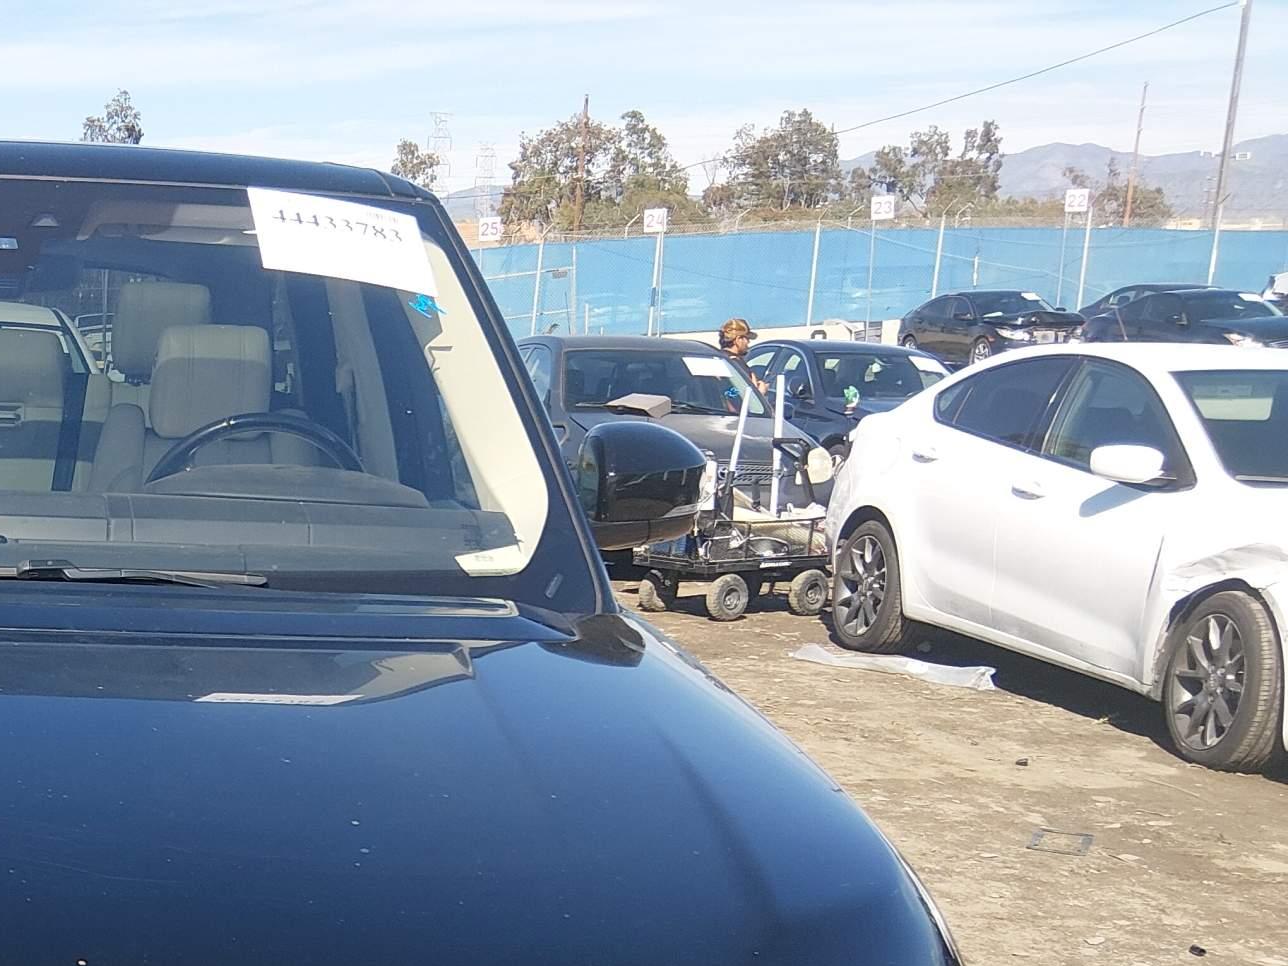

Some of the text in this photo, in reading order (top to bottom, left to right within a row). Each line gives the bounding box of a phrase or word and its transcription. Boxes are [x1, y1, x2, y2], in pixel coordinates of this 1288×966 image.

[873, 201, 893, 215] 23
[1067, 194, 1086, 208] 22
[272, 208, 403, 242] 44433783
[646, 213, 663, 228] 24
[480, 222, 499, 236] 25
